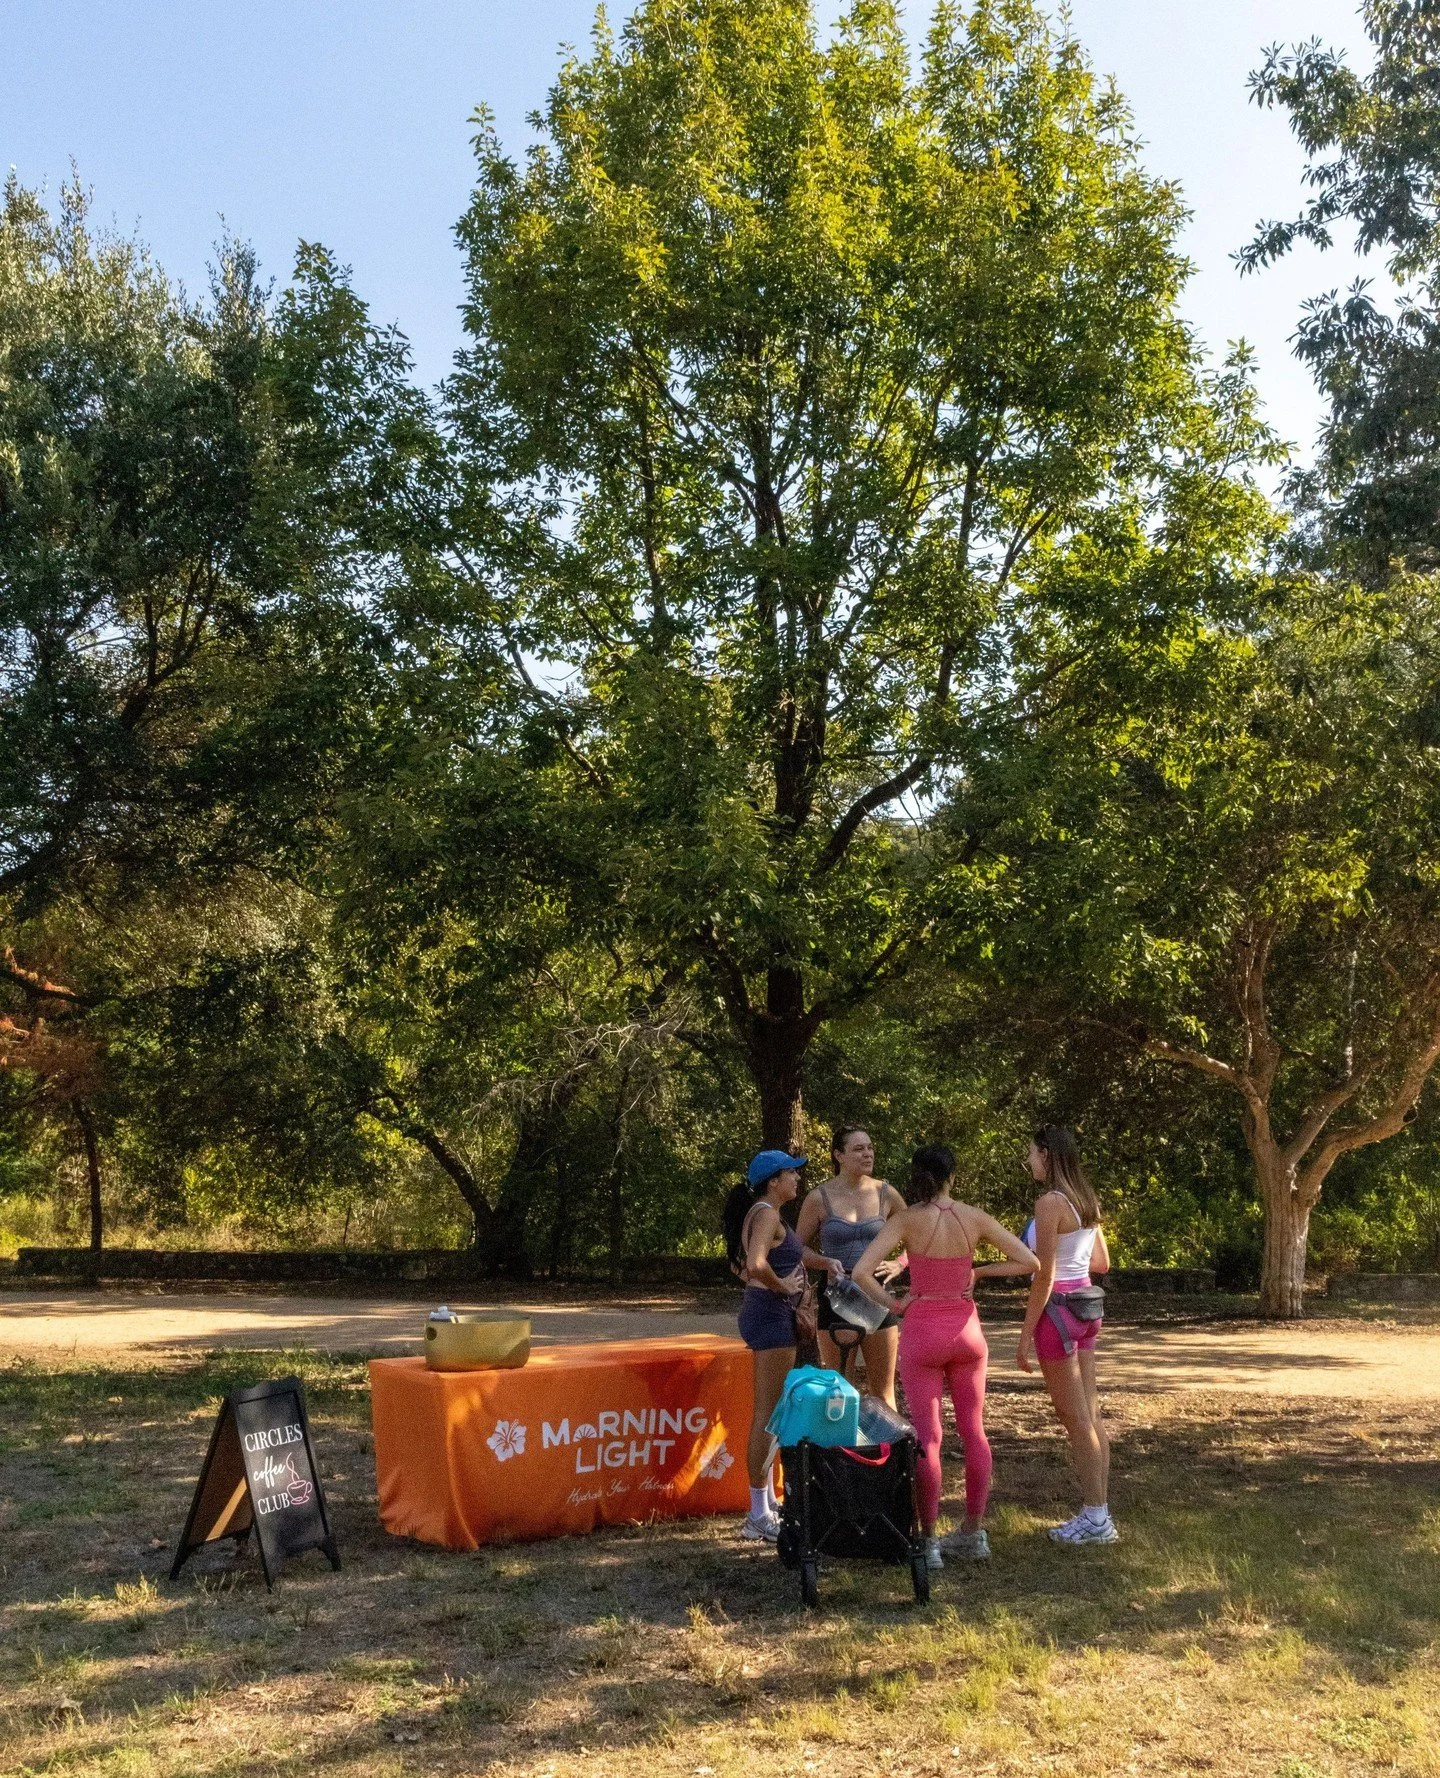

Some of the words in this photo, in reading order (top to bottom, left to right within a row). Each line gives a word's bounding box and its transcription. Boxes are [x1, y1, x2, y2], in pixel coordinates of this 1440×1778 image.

[244, 1423, 303, 1452] CIRCLES
[575, 1439, 675, 1474] LIGHT
[253, 1456, 286, 1488] coffee
[257, 1492, 290, 1515] CLUB
